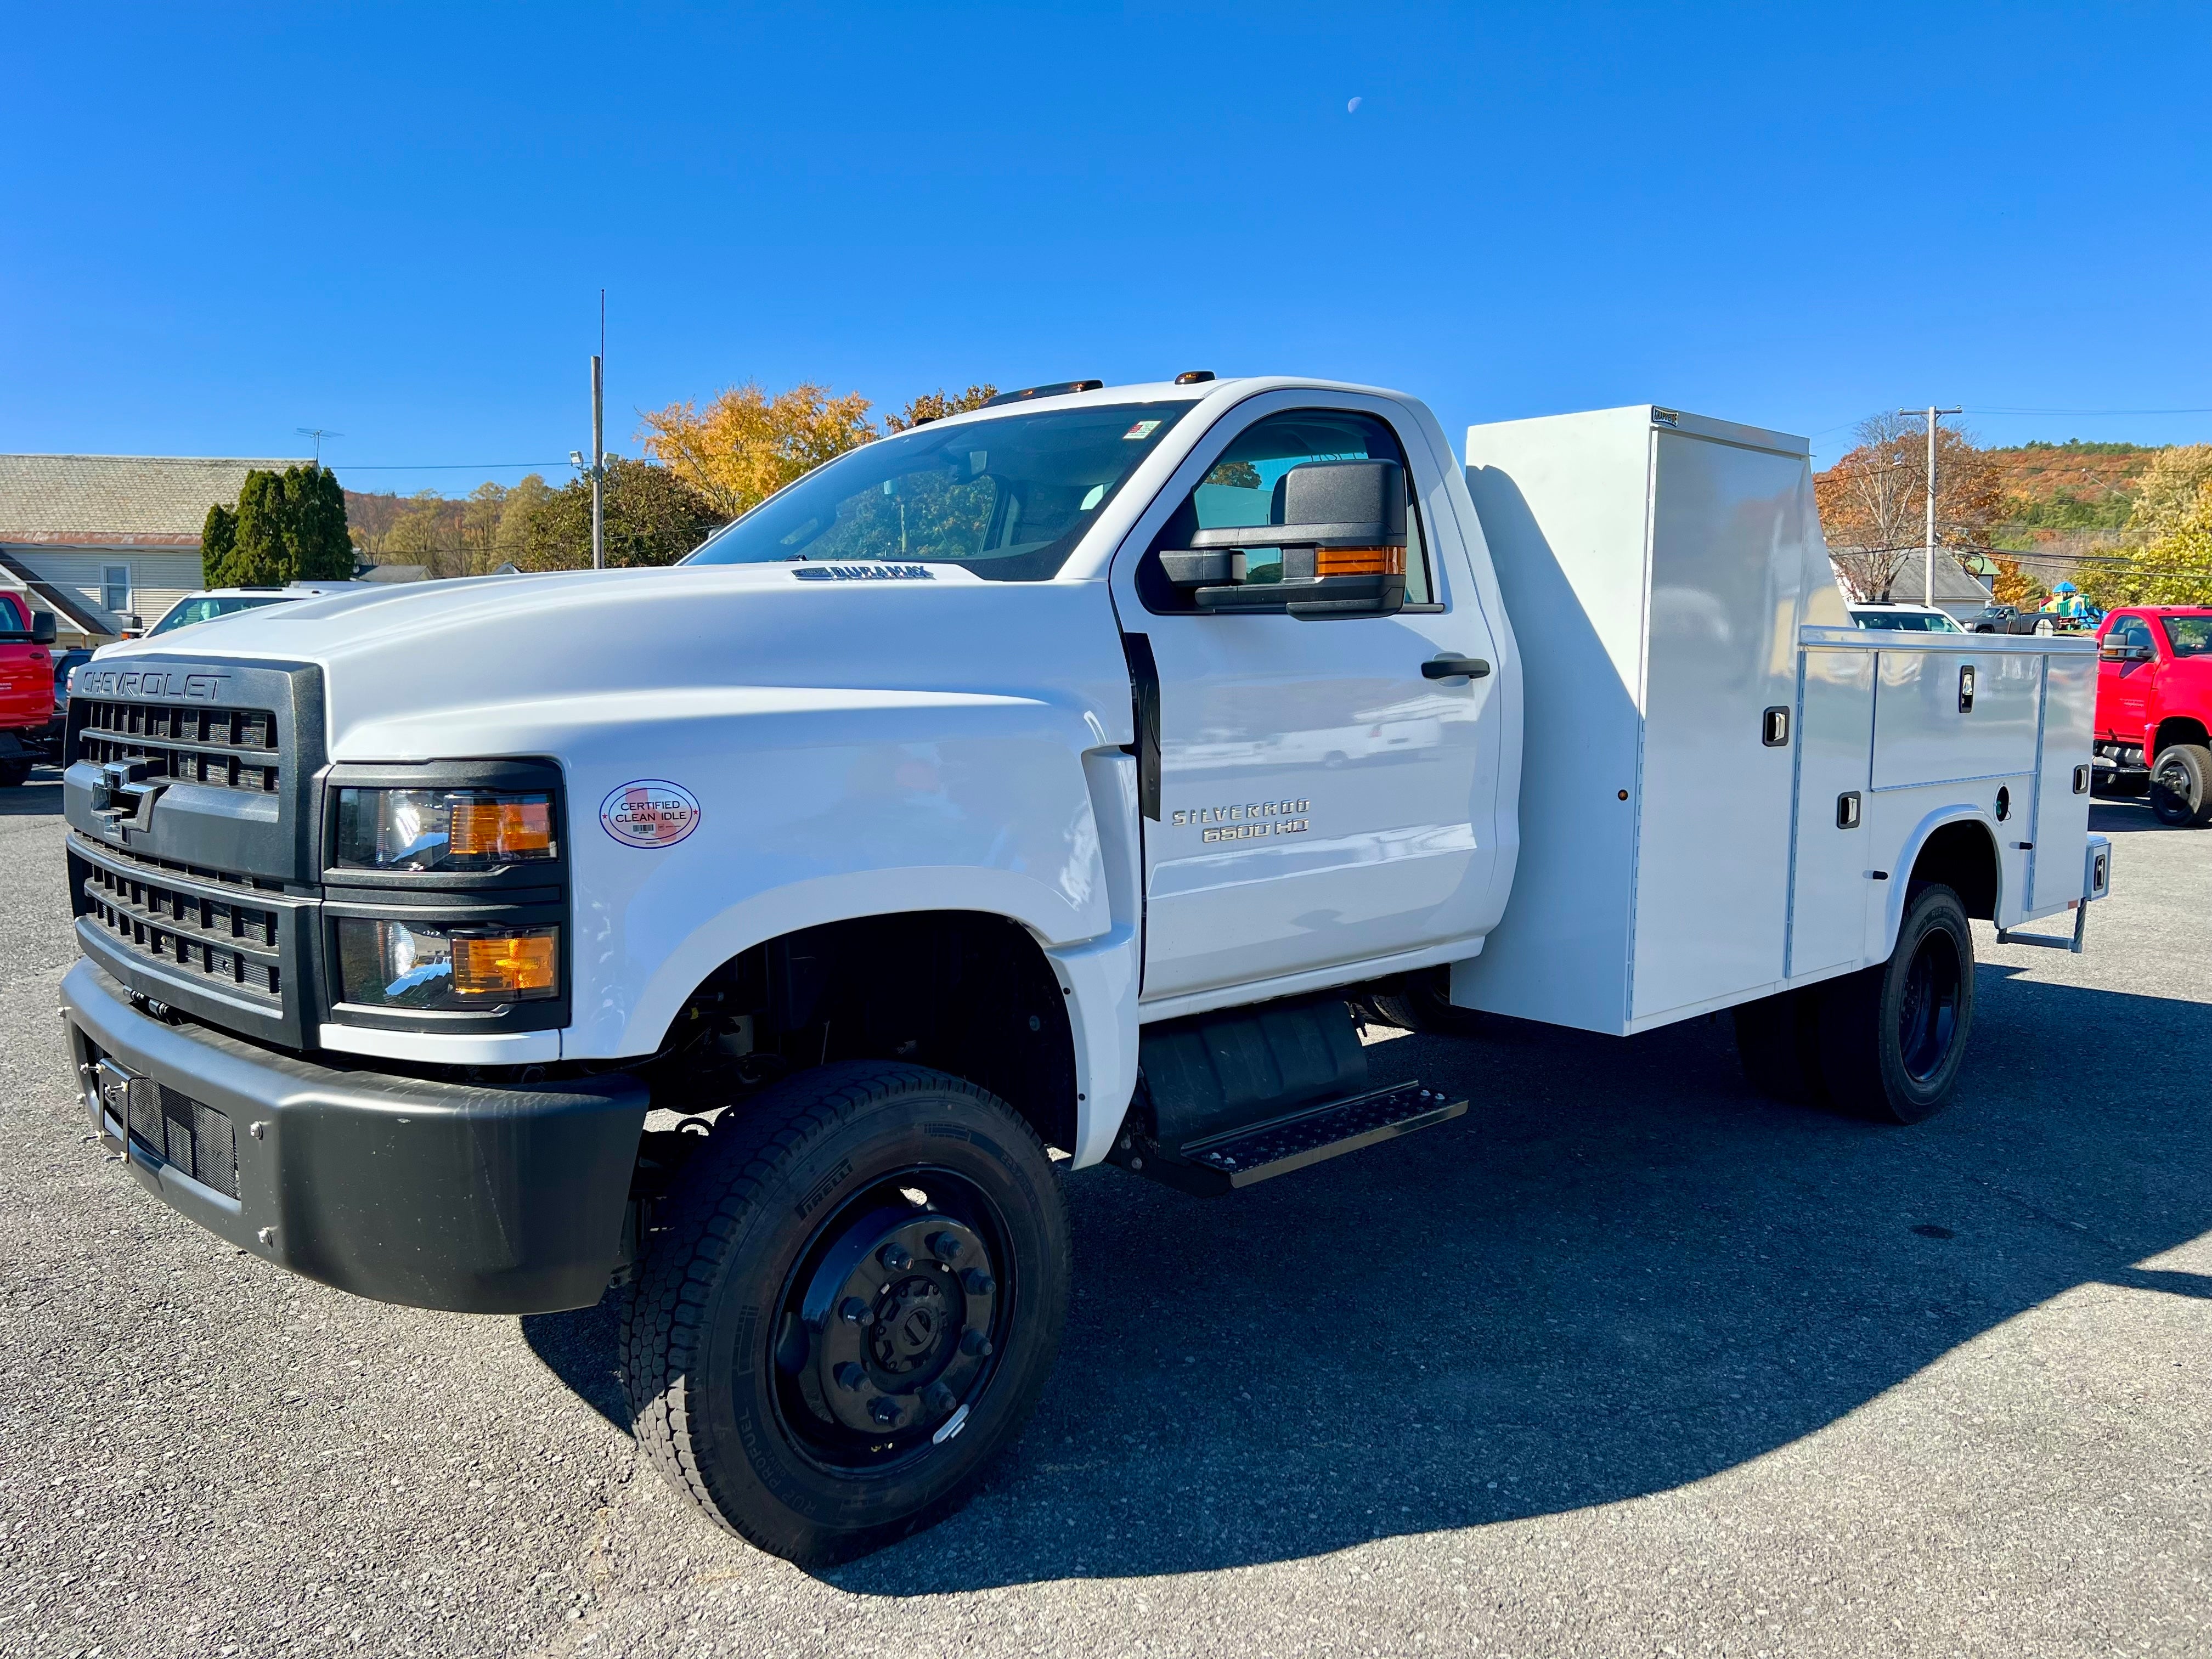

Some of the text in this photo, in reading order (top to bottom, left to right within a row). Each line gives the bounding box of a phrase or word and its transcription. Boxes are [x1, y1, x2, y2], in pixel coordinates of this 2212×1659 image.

[829, 566, 932, 579] DURAMAX
[82, 672, 232, 701] CHEVROLET
[615, 811, 687, 823] CLEAN IDLE
[620, 800, 680, 811] CERTIFIED
[1172, 798, 1310, 826] SILVERADO
[1203, 817, 1309, 843] 6500 HD
[795, 1158, 854, 1221] PIRELLI
[739, 1406, 782, 1489] PROFUEL
